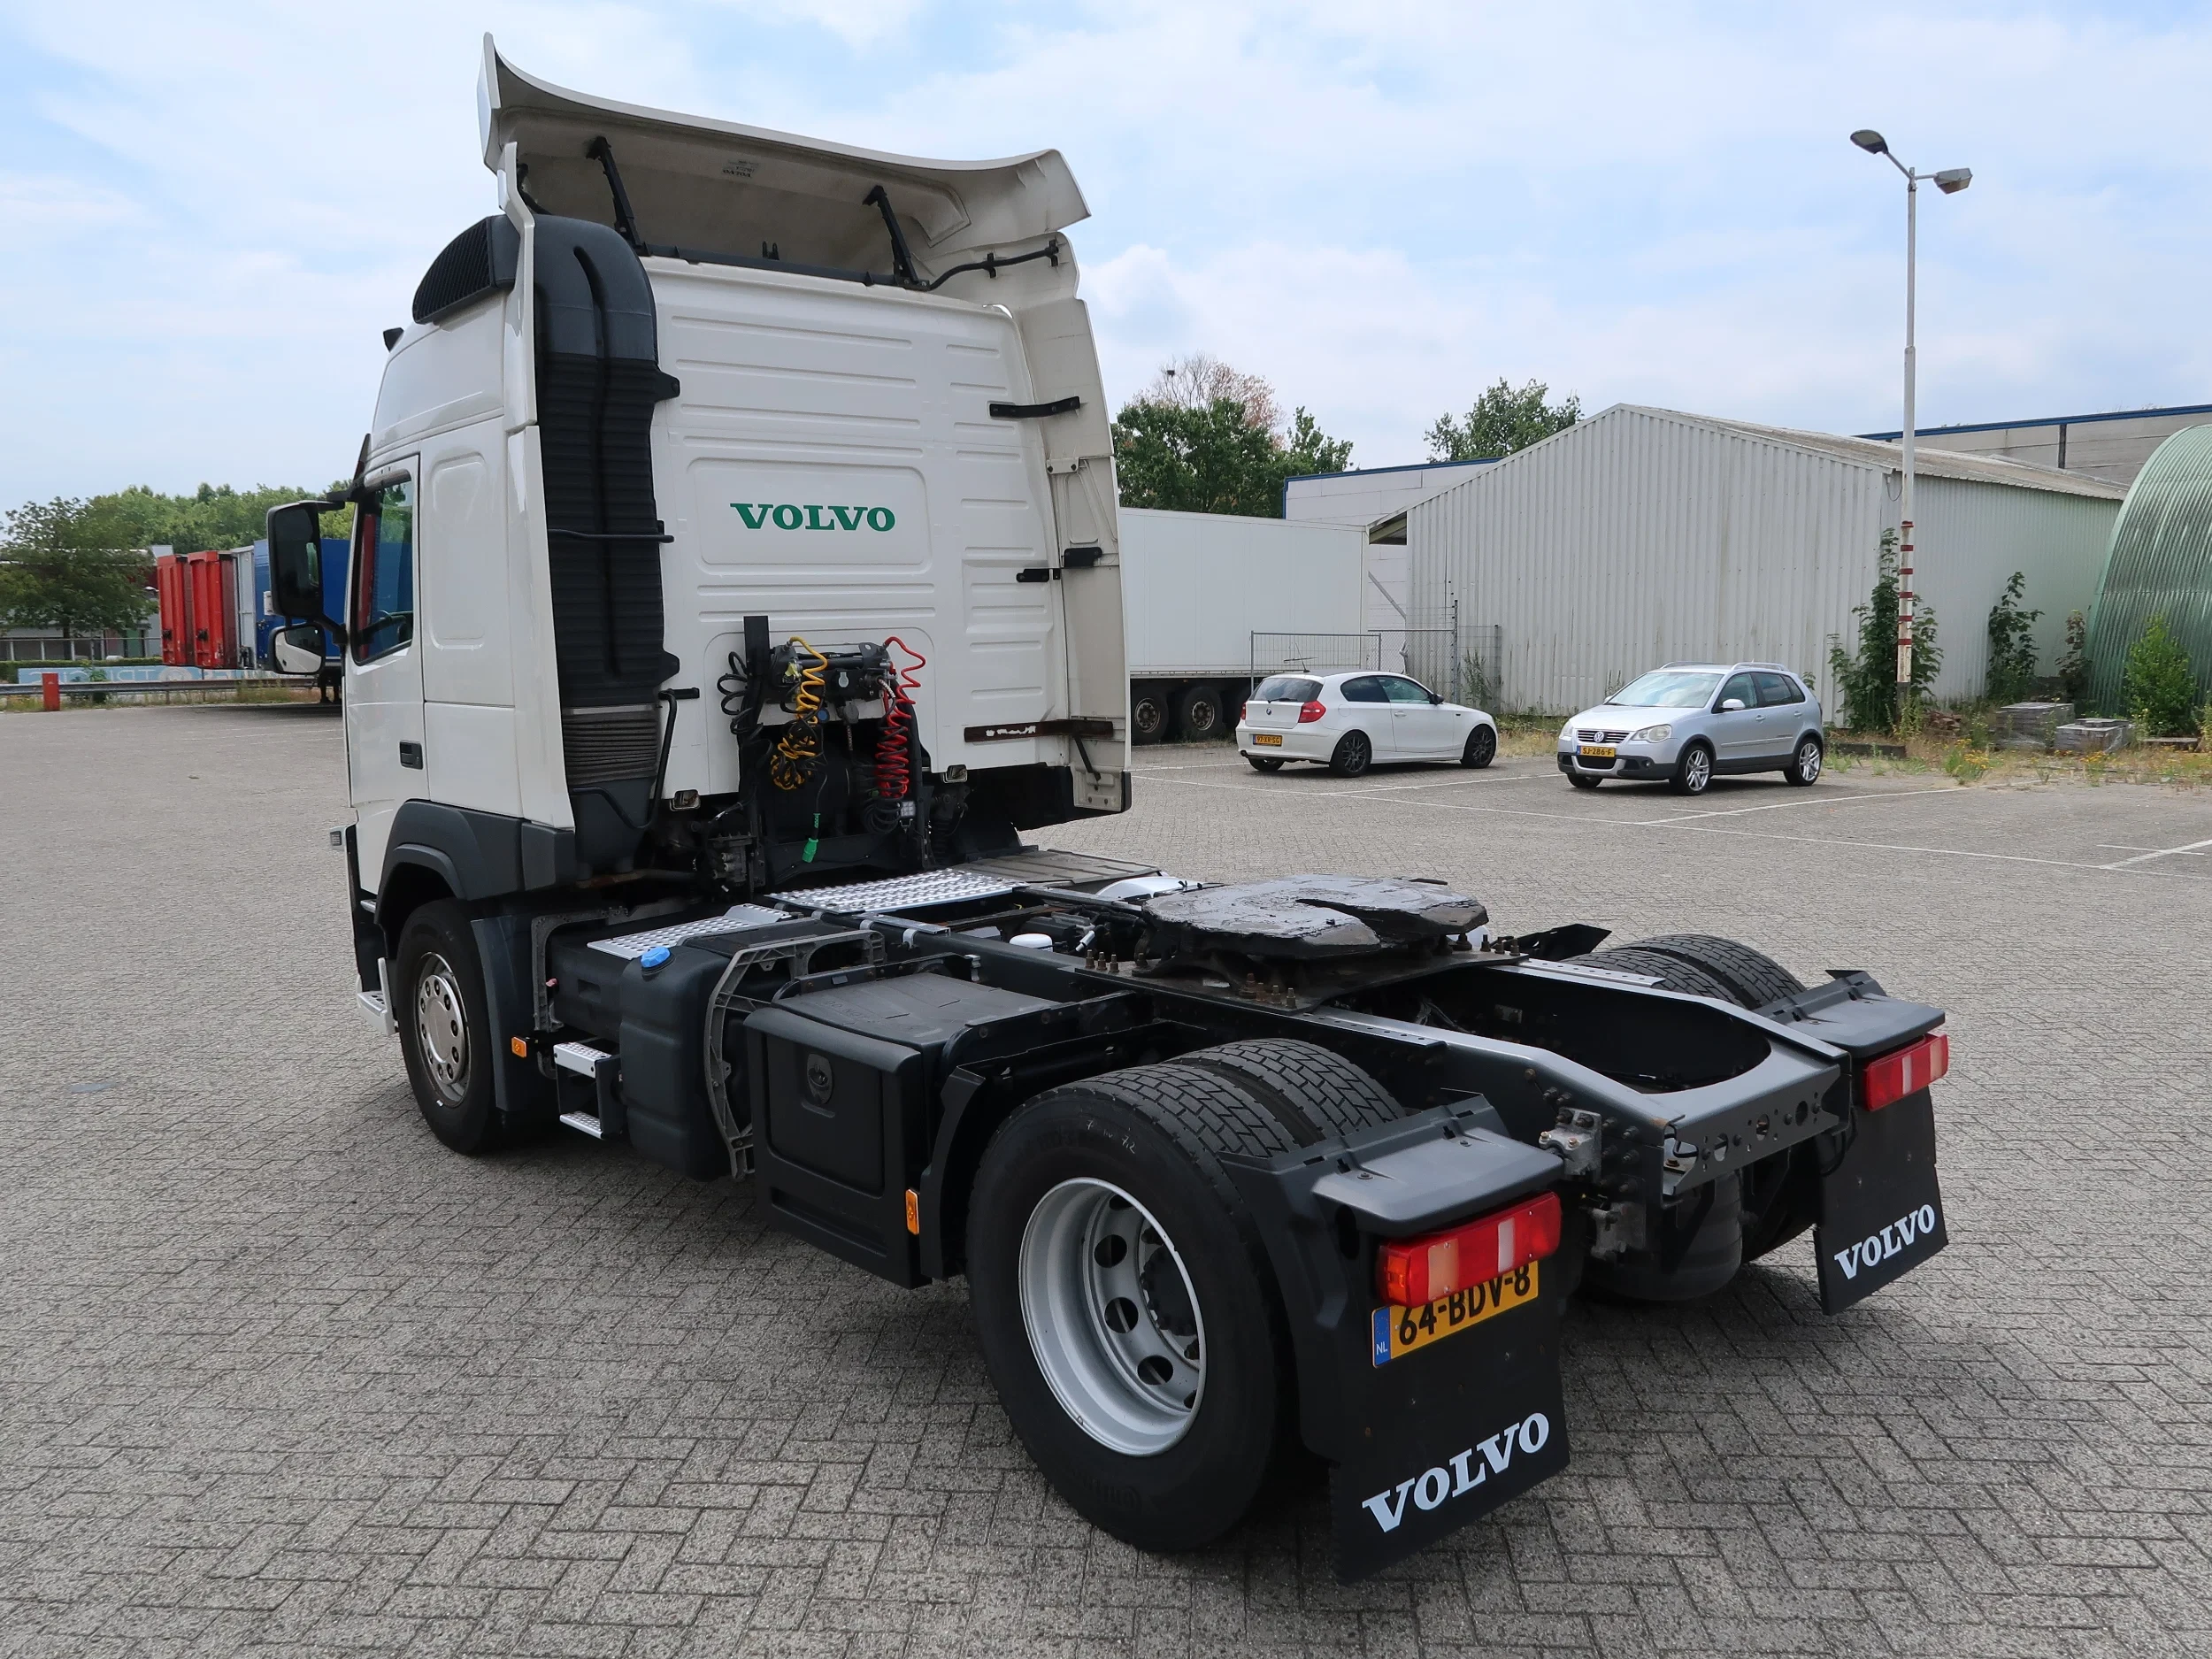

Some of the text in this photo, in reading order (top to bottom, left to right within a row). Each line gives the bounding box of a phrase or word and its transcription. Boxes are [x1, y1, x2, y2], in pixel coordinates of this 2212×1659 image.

[732, 503, 896, 532] VOLVO
[1582, 747, 1612, 756] SJ-286-F
[1833, 1204, 1936, 1280] VOLVO
[1376, 1263, 1531, 1356] NL 64-BDV-8
[1362, 1412, 1549, 1533] VOLVO
